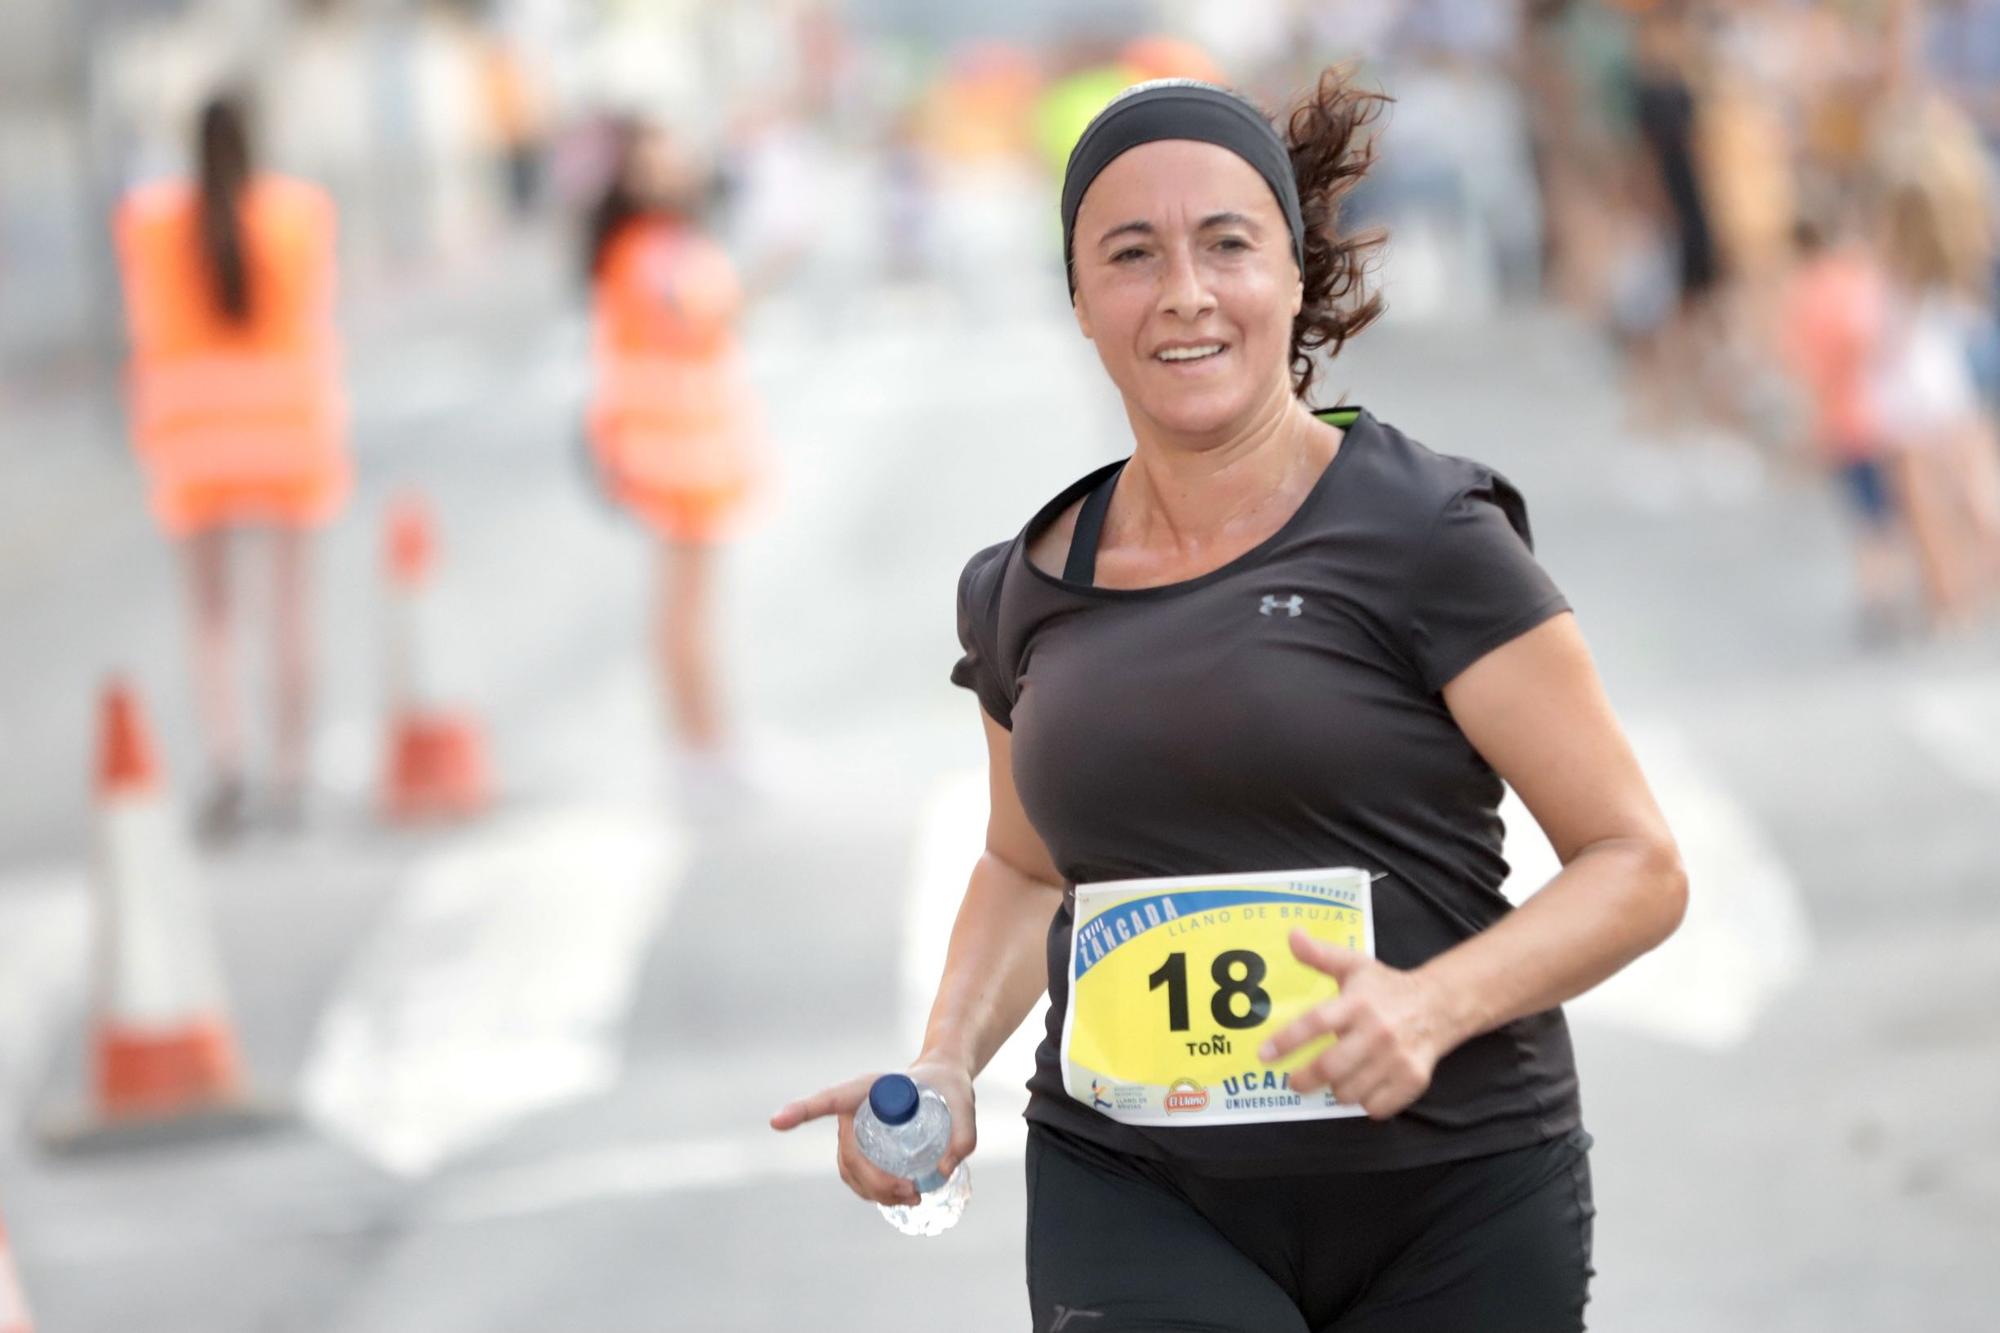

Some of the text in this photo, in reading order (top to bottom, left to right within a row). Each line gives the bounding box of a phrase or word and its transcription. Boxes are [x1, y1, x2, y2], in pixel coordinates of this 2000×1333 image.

[1079, 917, 1105, 945] XVIII
[1080, 897, 1179, 969] ZANCADA
[1167, 906, 1358, 937] LLANO DE BRUJAS
[1149, 949, 1272, 1032] 18
[1186, 1034, 1232, 1056] TOÑI
[1226, 1095, 1302, 1110] UNIVERSIDAD
